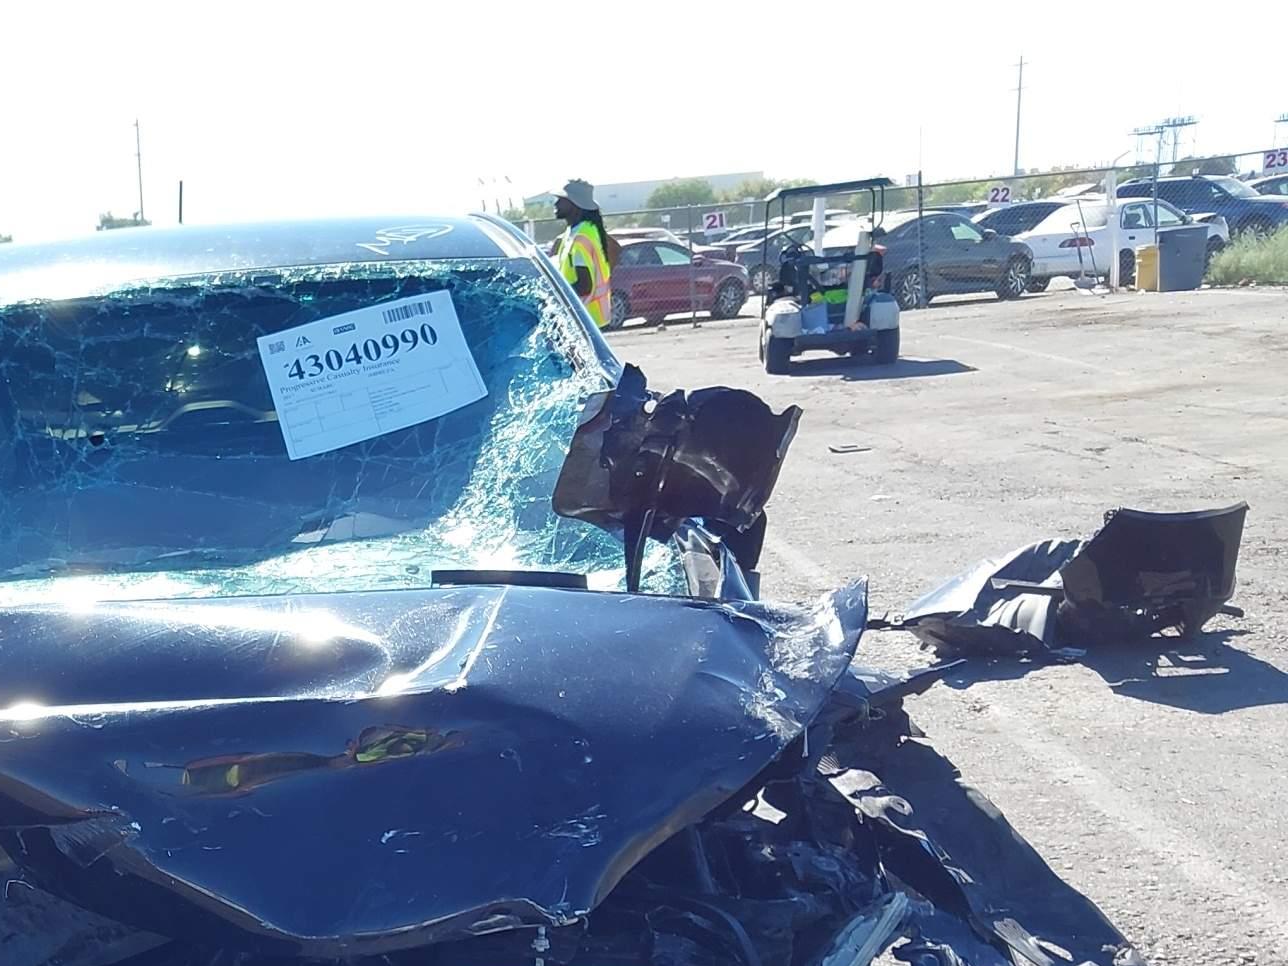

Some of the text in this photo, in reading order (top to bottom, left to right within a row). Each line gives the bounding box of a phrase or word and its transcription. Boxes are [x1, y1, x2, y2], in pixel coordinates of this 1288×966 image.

[1265, 152, 1288, 169] 23
[990, 187, 1010, 203] 22
[705, 213, 724, 229] 21
[287, 323, 438, 381] 43040990
[279, 376, 326, 395] Progressive
[326, 366, 361, 382] Casualty
[363, 358, 401, 373] Insurance
